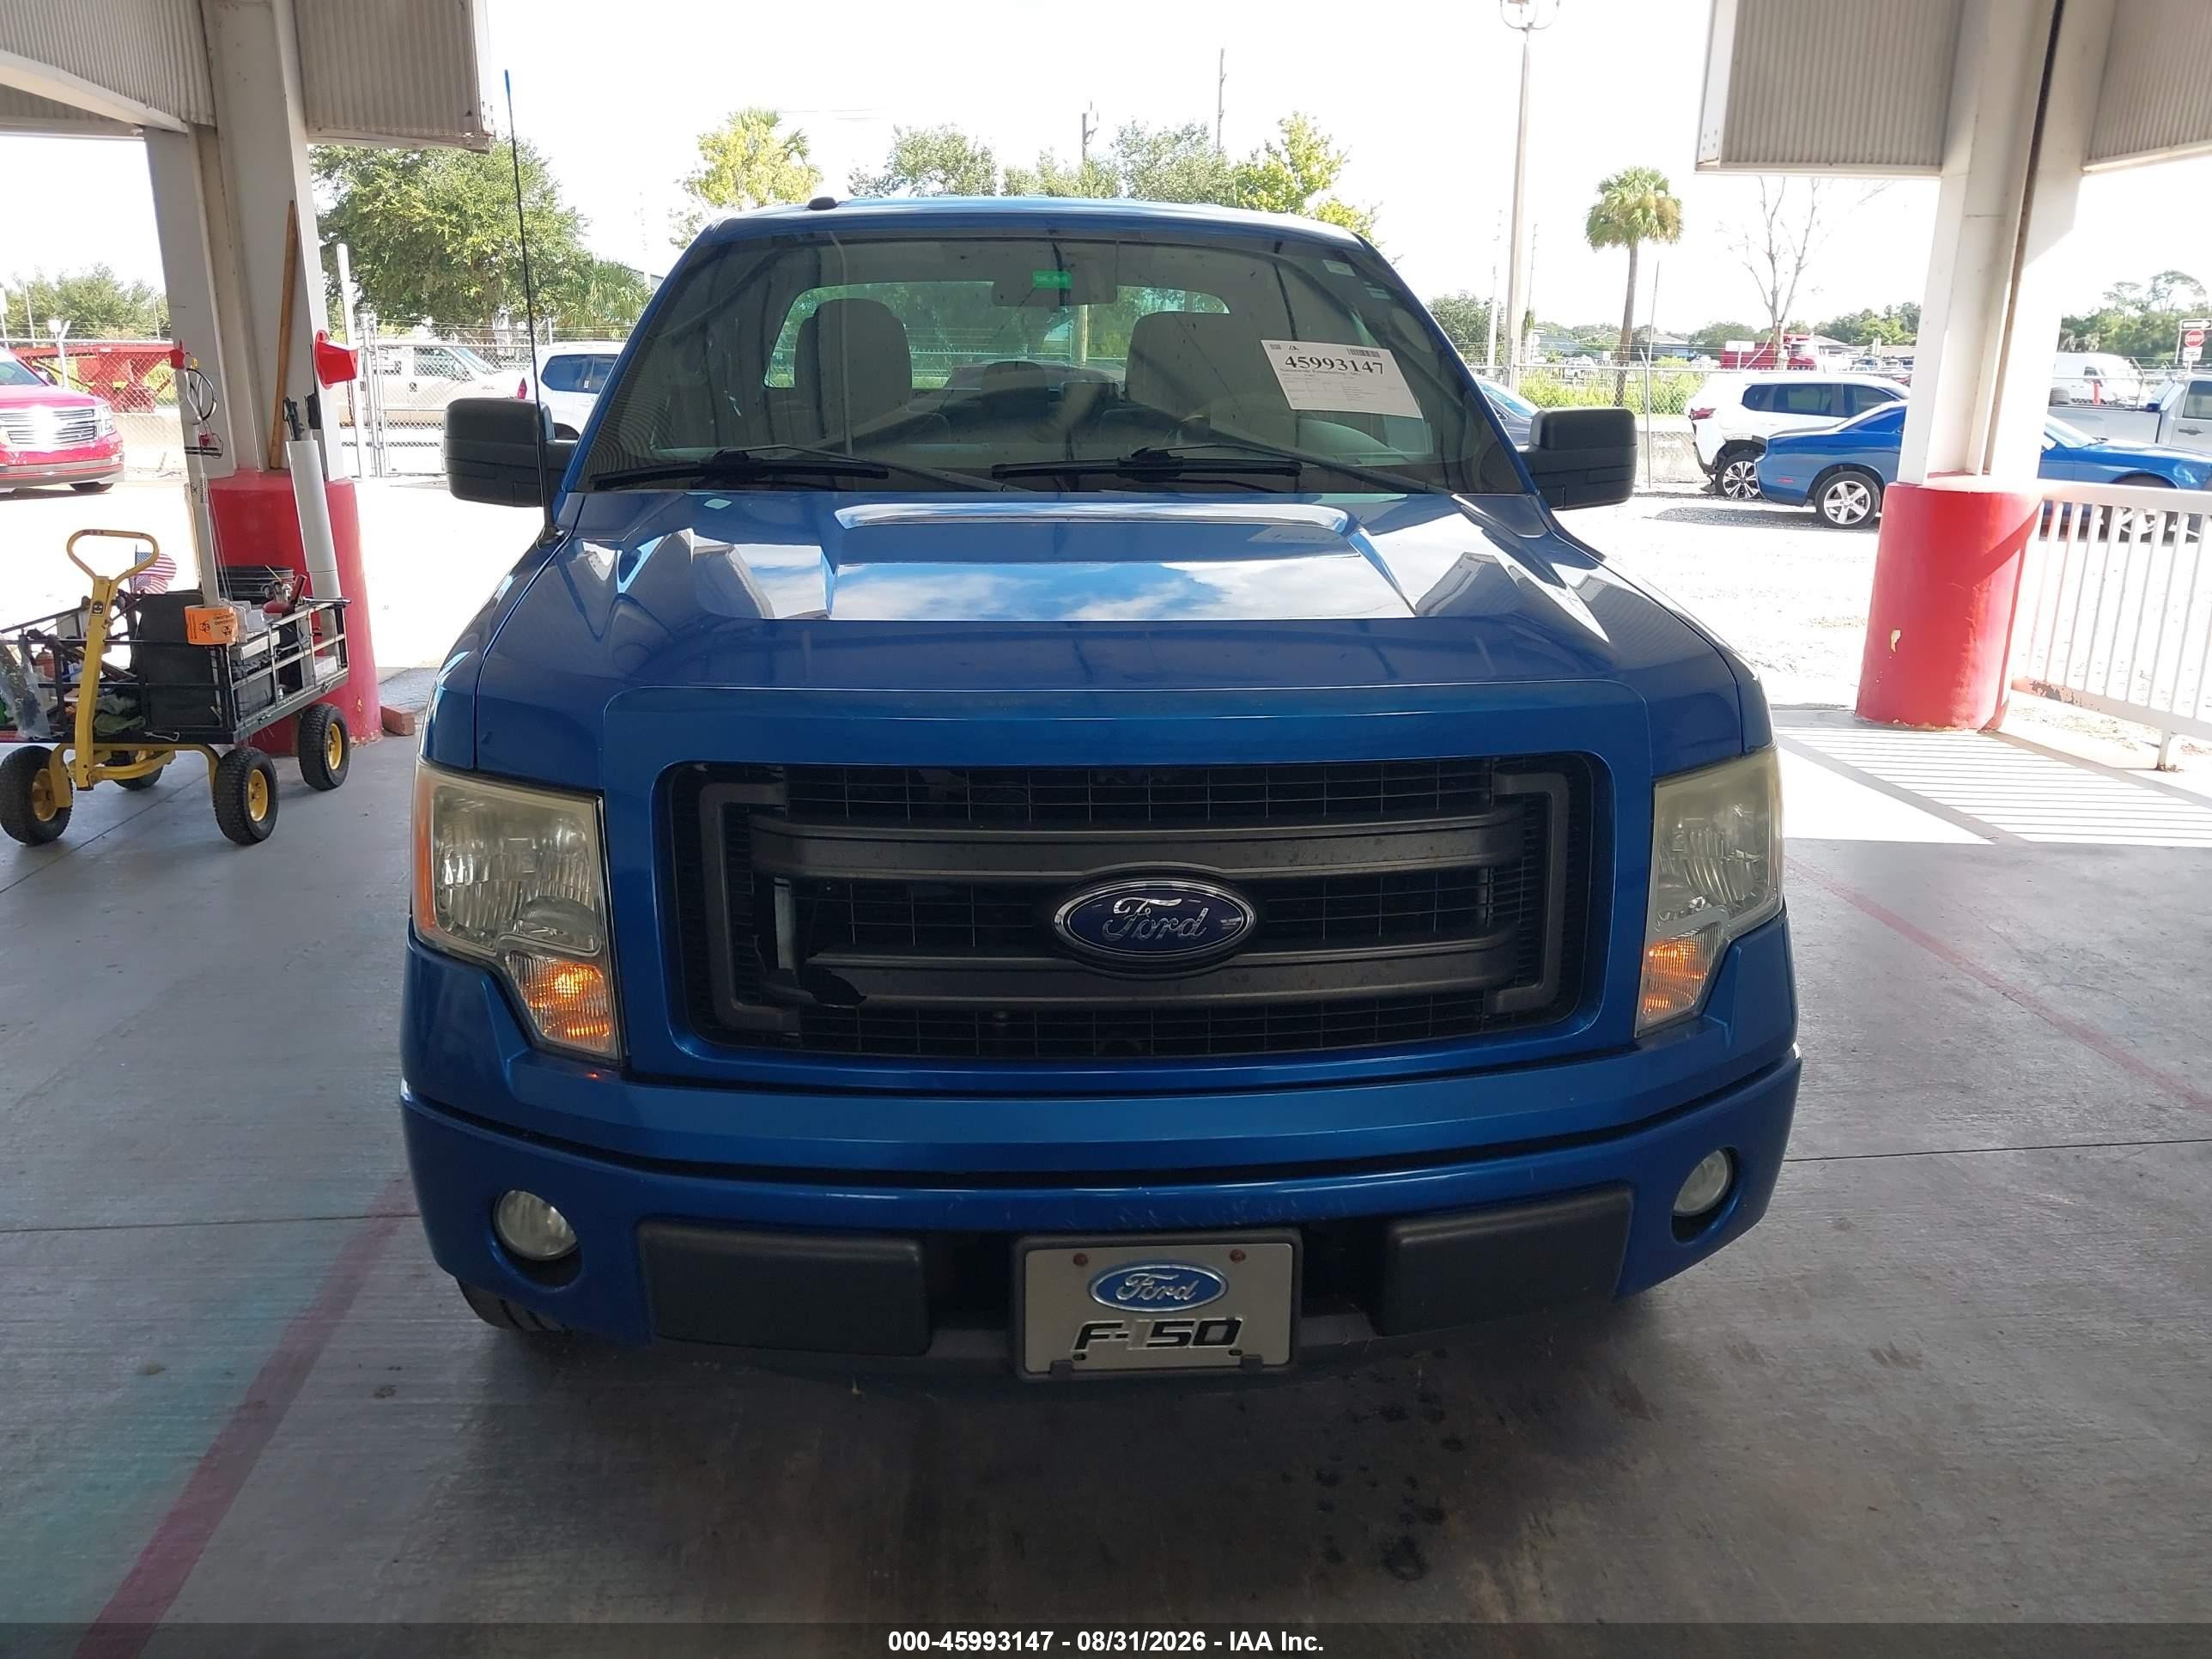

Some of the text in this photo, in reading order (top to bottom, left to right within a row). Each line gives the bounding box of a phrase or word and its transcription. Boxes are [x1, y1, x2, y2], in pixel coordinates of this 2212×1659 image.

[1285, 355, 1383, 374] 45993147
[1102, 896, 1209, 941] Ford
[1115, 1273, 1199, 1301] Ford
[1072, 1316, 1244, 1352] F-150
